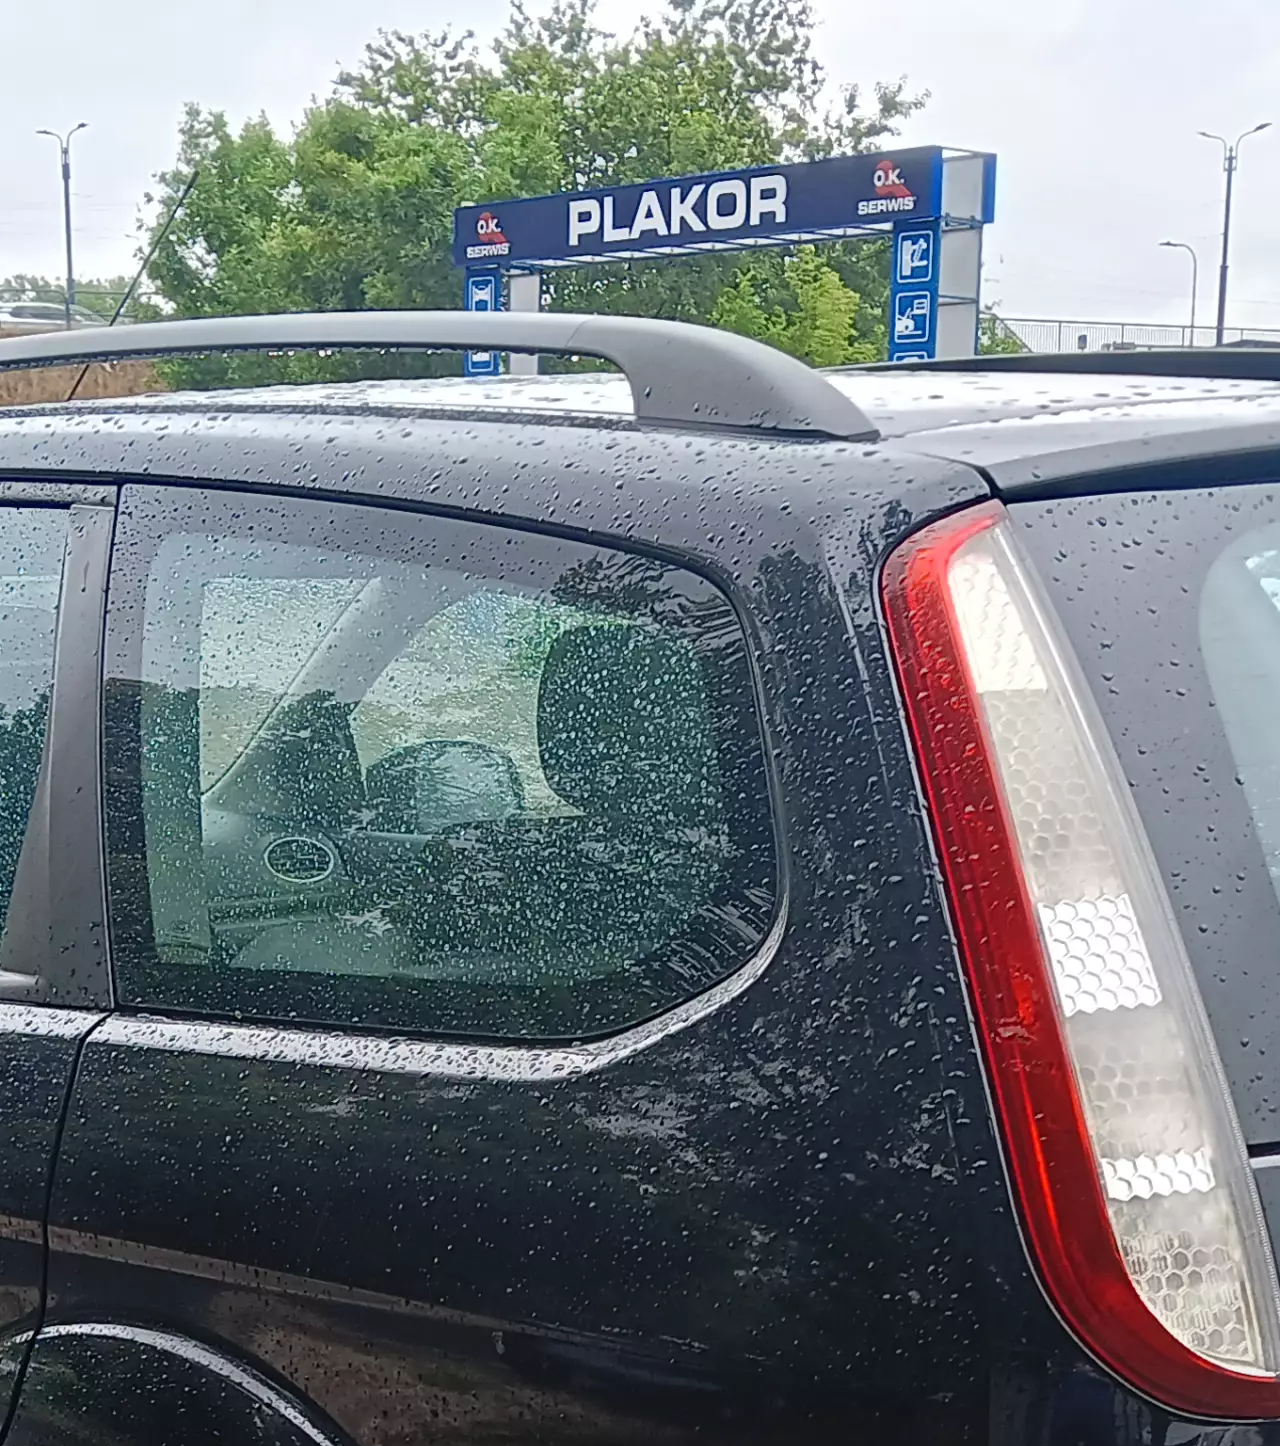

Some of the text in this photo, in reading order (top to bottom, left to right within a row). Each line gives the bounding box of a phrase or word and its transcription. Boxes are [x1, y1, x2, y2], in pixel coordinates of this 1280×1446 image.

[873, 168, 905, 187] O.K.
[568, 174, 787, 246] PLAKOR
[857, 196, 915, 215] SERWIS
[477, 218, 502, 234] O.K.
[466, 243, 510, 259] SERWIS
